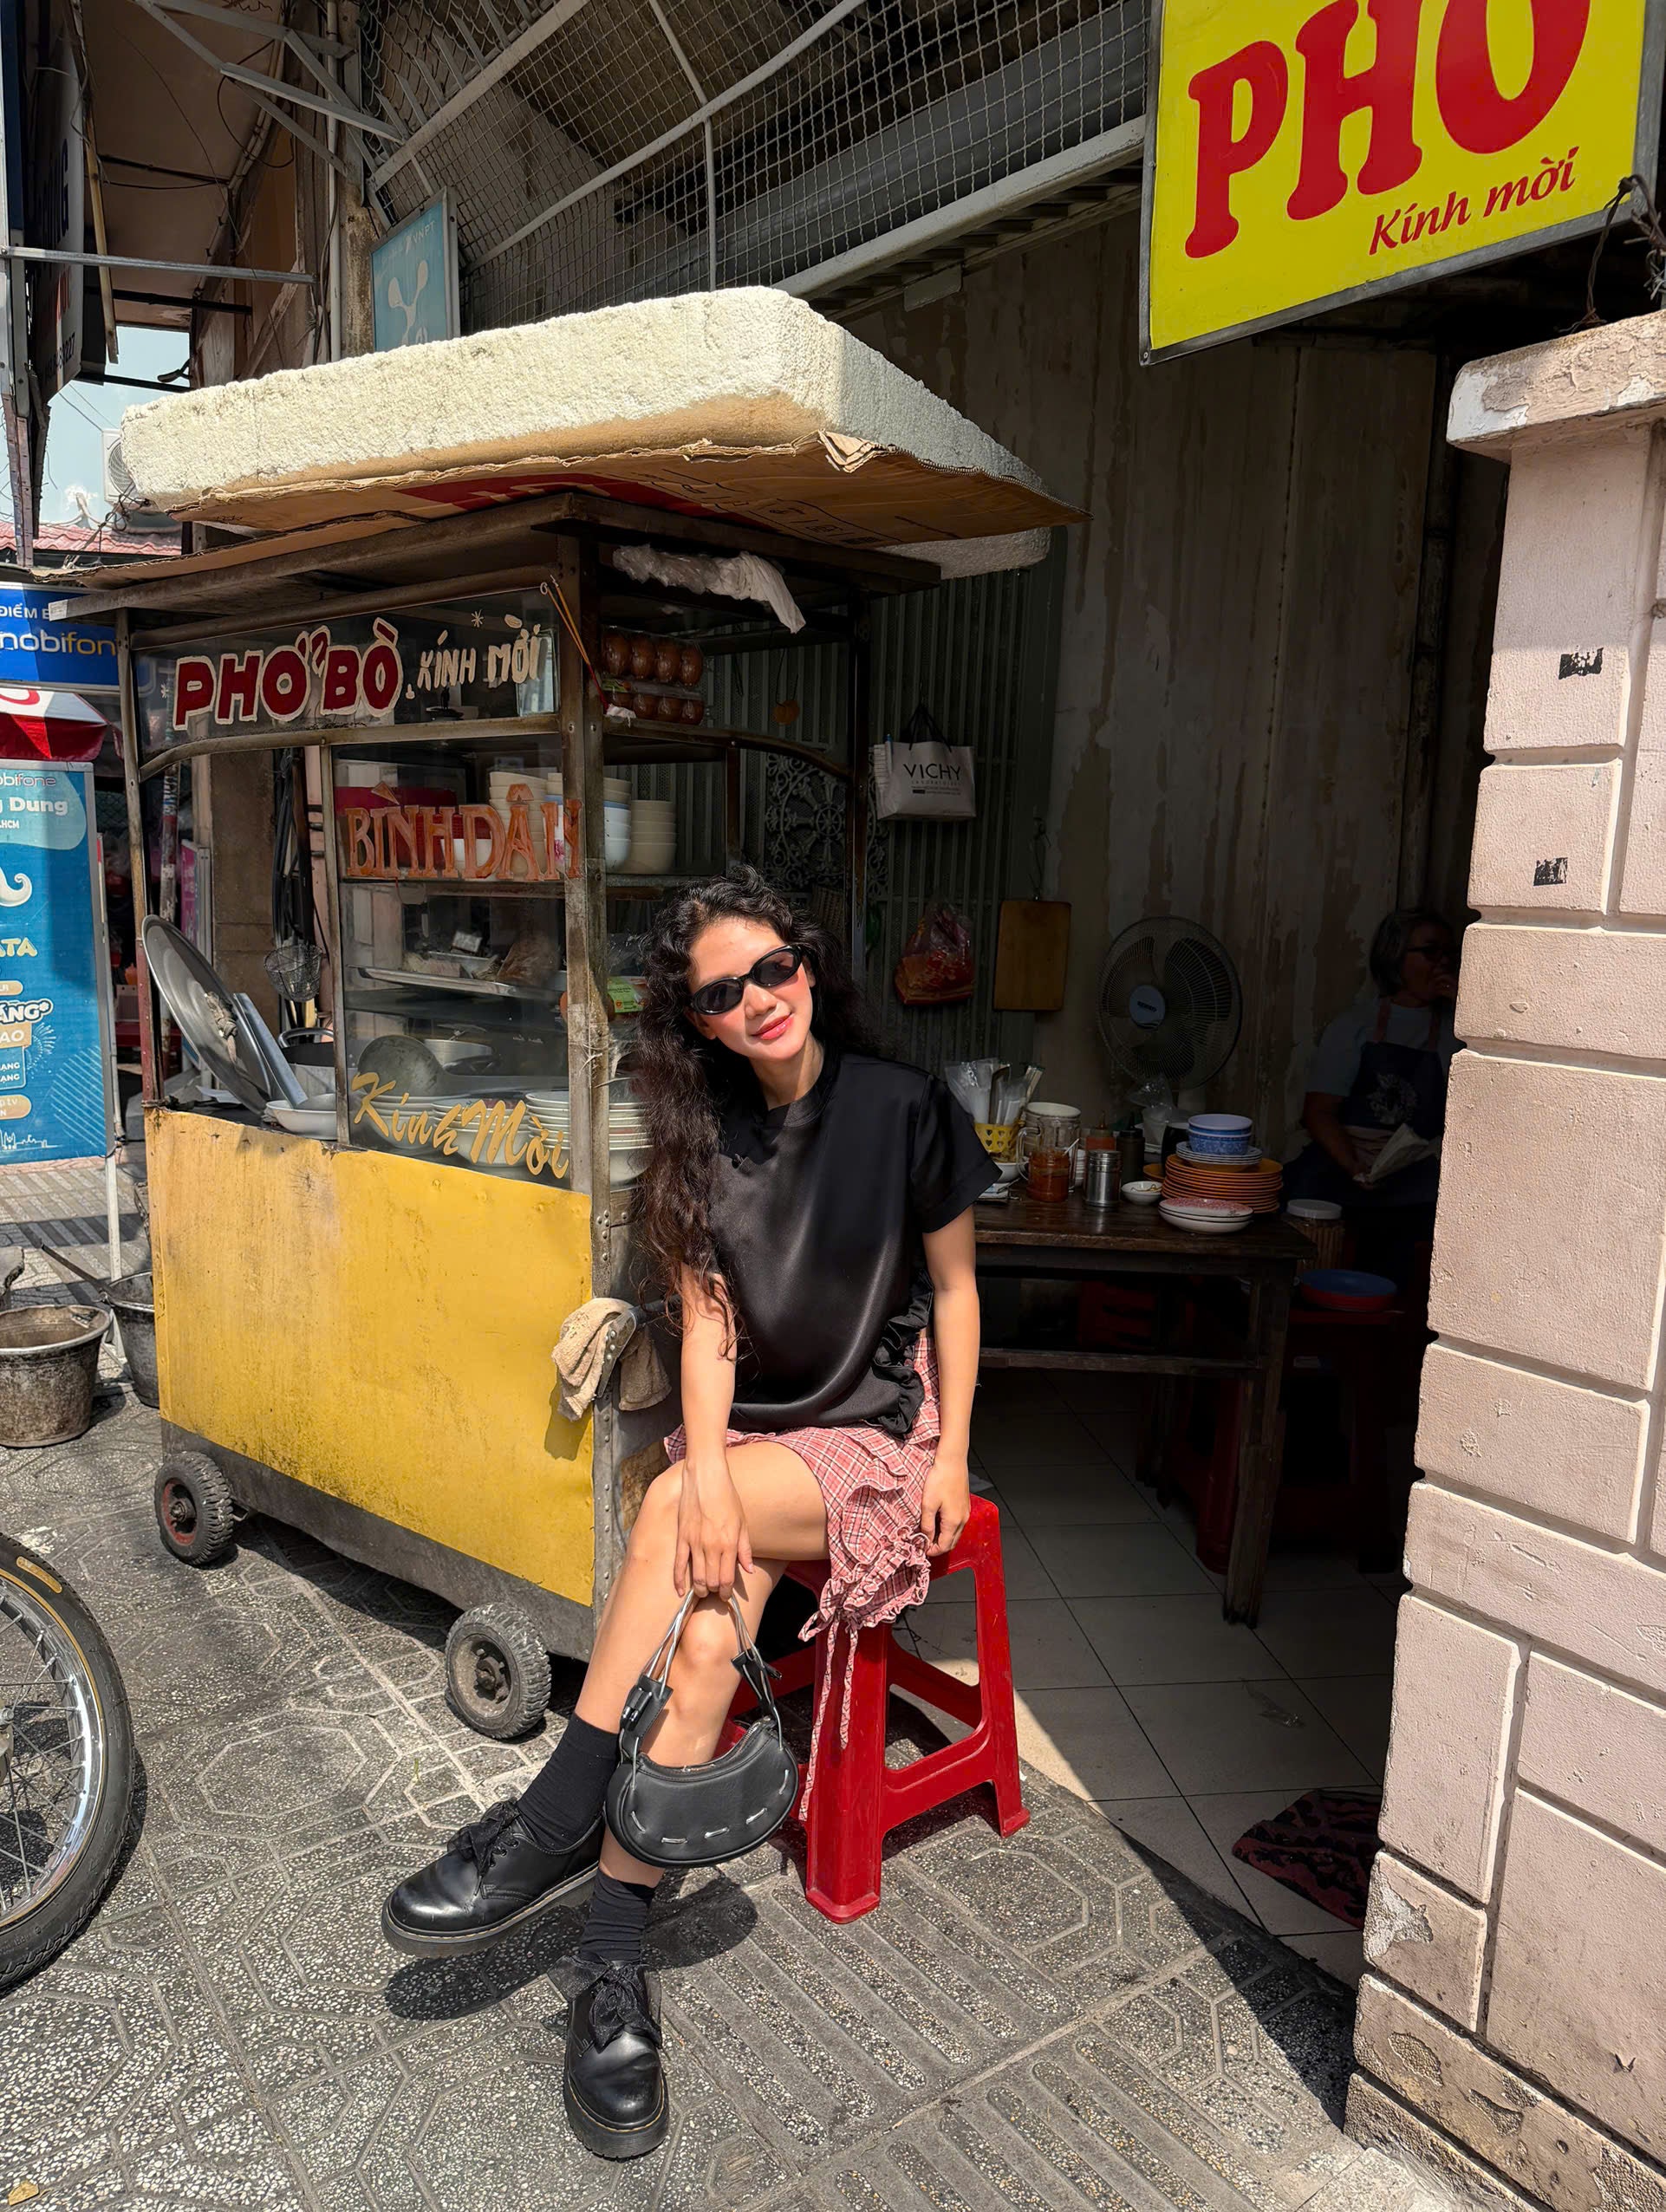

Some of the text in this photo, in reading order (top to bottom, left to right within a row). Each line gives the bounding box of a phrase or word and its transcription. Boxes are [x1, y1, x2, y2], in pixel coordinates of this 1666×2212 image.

[1369, 146, 1579, 255] Kính mời
[413, 220, 435, 244] VNPT
[321, 617, 402, 717] BÒ
[417, 629, 476, 692] KÍNH
[903, 764, 960, 780] VICHY
[10, 797, 68, 816] Dung
[347, 781, 584, 882] BÌNH DÂN
[0, 937, 38, 957] TA
[352, 1072, 569, 1179] Kính Mời
